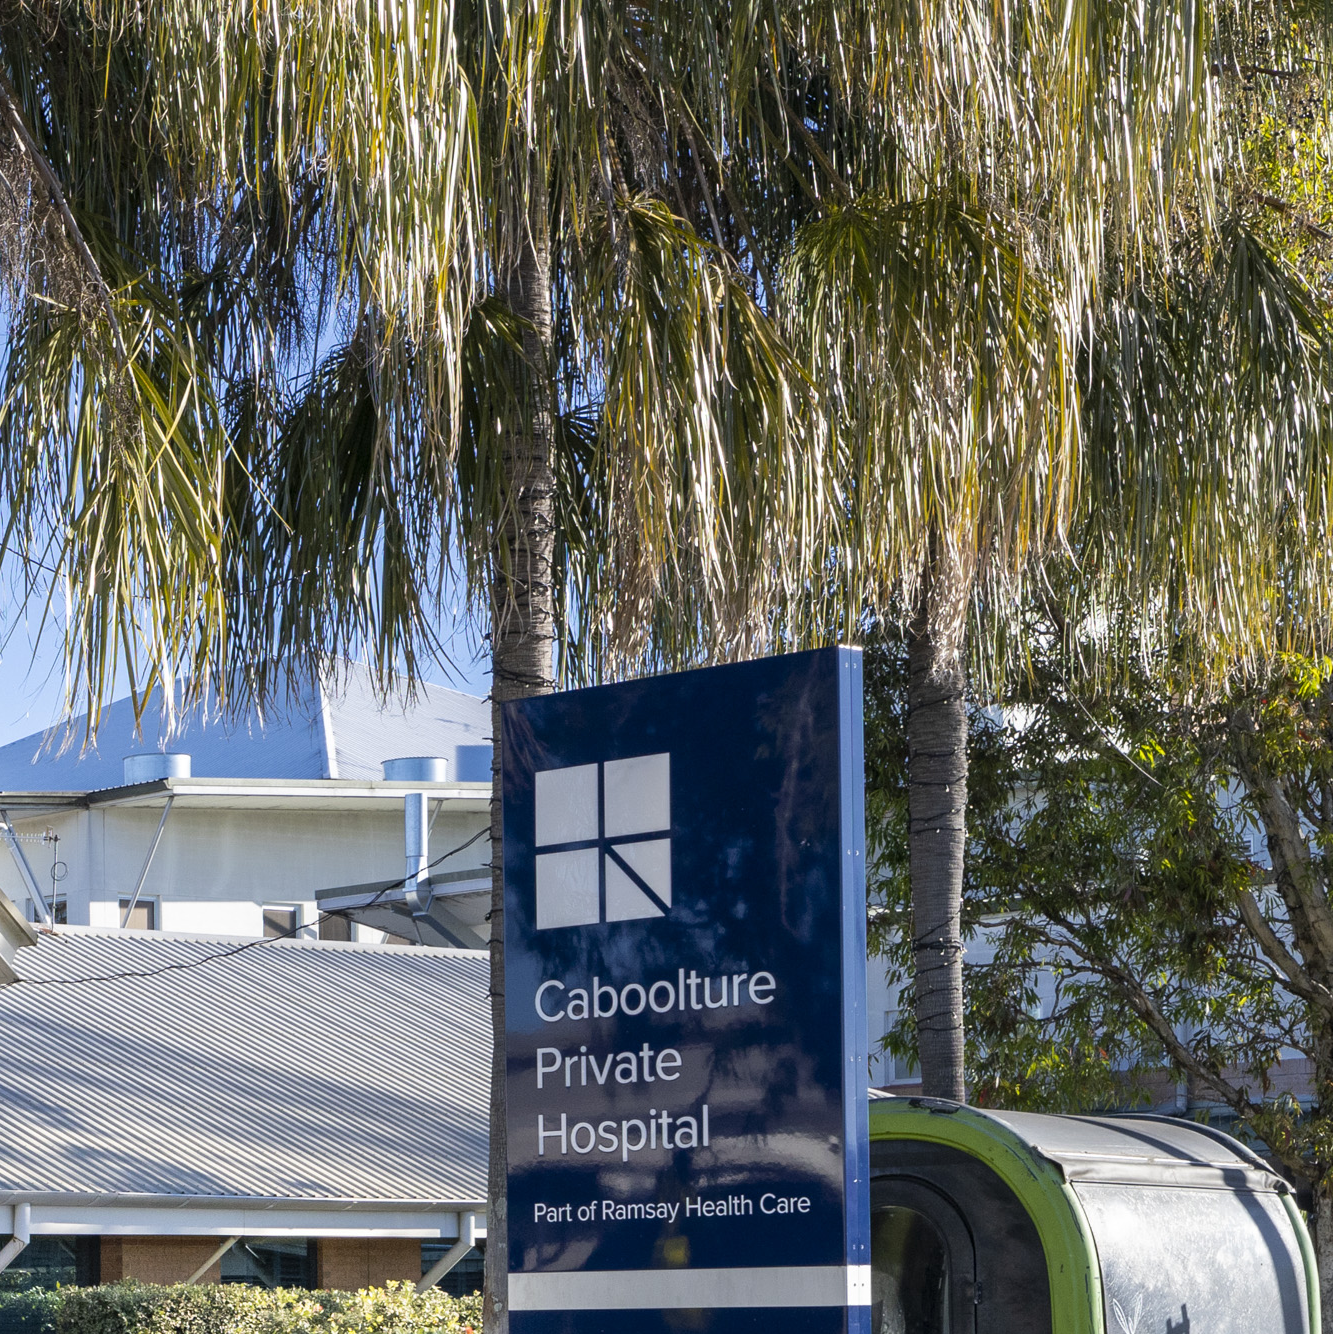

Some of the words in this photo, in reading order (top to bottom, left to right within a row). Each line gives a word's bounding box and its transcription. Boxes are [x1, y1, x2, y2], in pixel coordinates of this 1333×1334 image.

[535, 968, 776, 1022] Caboolture
[537, 1042, 682, 1088] Private
[538, 1104, 709, 1162] Hospital
[534, 1203, 572, 1223] Part
[577, 1201, 597, 1221] of
[602, 1200, 680, 1223] Ramsay
[686, 1194, 753, 1217] Health
[760, 1193, 811, 1214] Care
